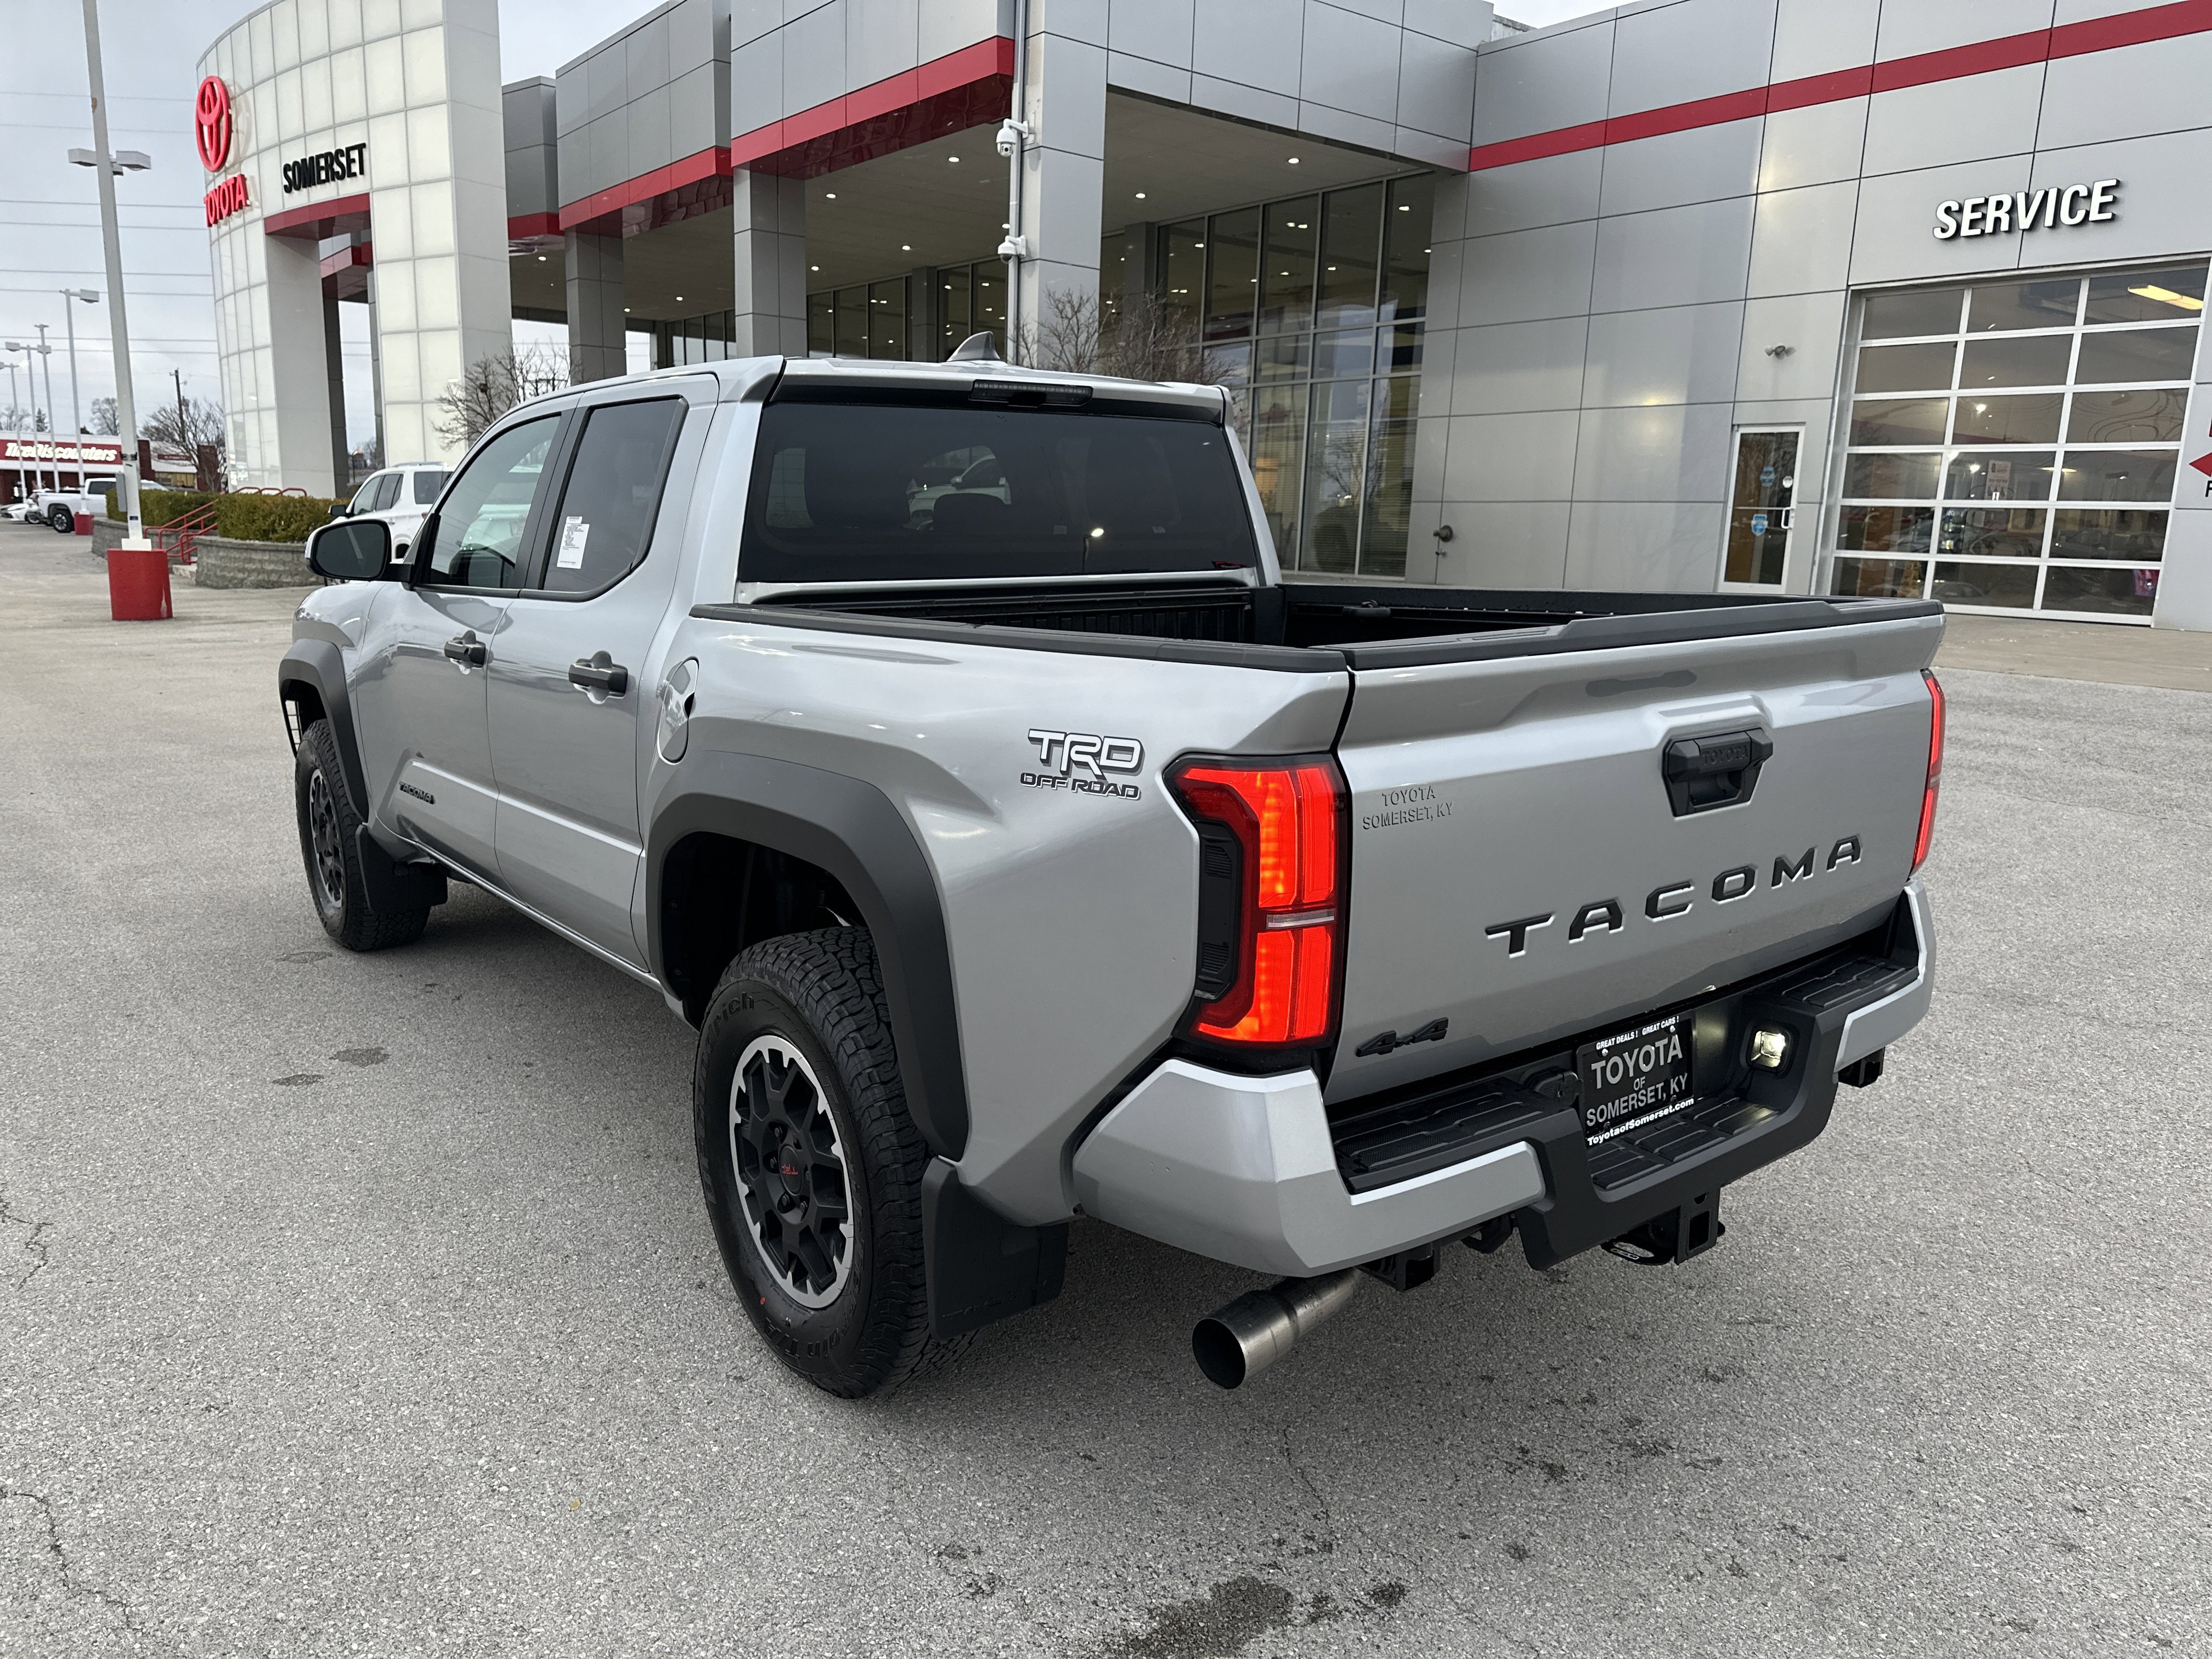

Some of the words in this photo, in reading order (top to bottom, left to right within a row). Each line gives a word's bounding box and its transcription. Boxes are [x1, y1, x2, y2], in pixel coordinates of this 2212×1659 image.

[283, 142, 366, 194] SOMERSET
[204, 173, 250, 228] TOYOTA
[1933, 178, 2121, 240] SERVICE
[1028, 729, 1145, 786] TRD
[1702, 745, 1749, 766] TOYOTA
[399, 781, 436, 805] TACOMA
[1020, 772, 1068, 791] OFF
[1071, 778, 1142, 800] ROAD
[1381, 785, 1436, 807] TOYOTA
[1362, 805, 1434, 830] SOMERSET,
[1436, 802, 1453, 817] KY
[1485, 833, 1863, 958] TACOMA
[1596, 1037, 1616, 1050] GREAT
[1641, 1024, 1661, 1036] GREAT
[1590, 1034, 1683, 1090] TOYOTA
[1633, 1076, 1646, 1091] OF
[1586, 1082, 1667, 1127] SOMERSET,
[1670, 1073, 1688, 1095] KY
[1587, 1097, 1695, 1146] ToyotaofSomerset.com
